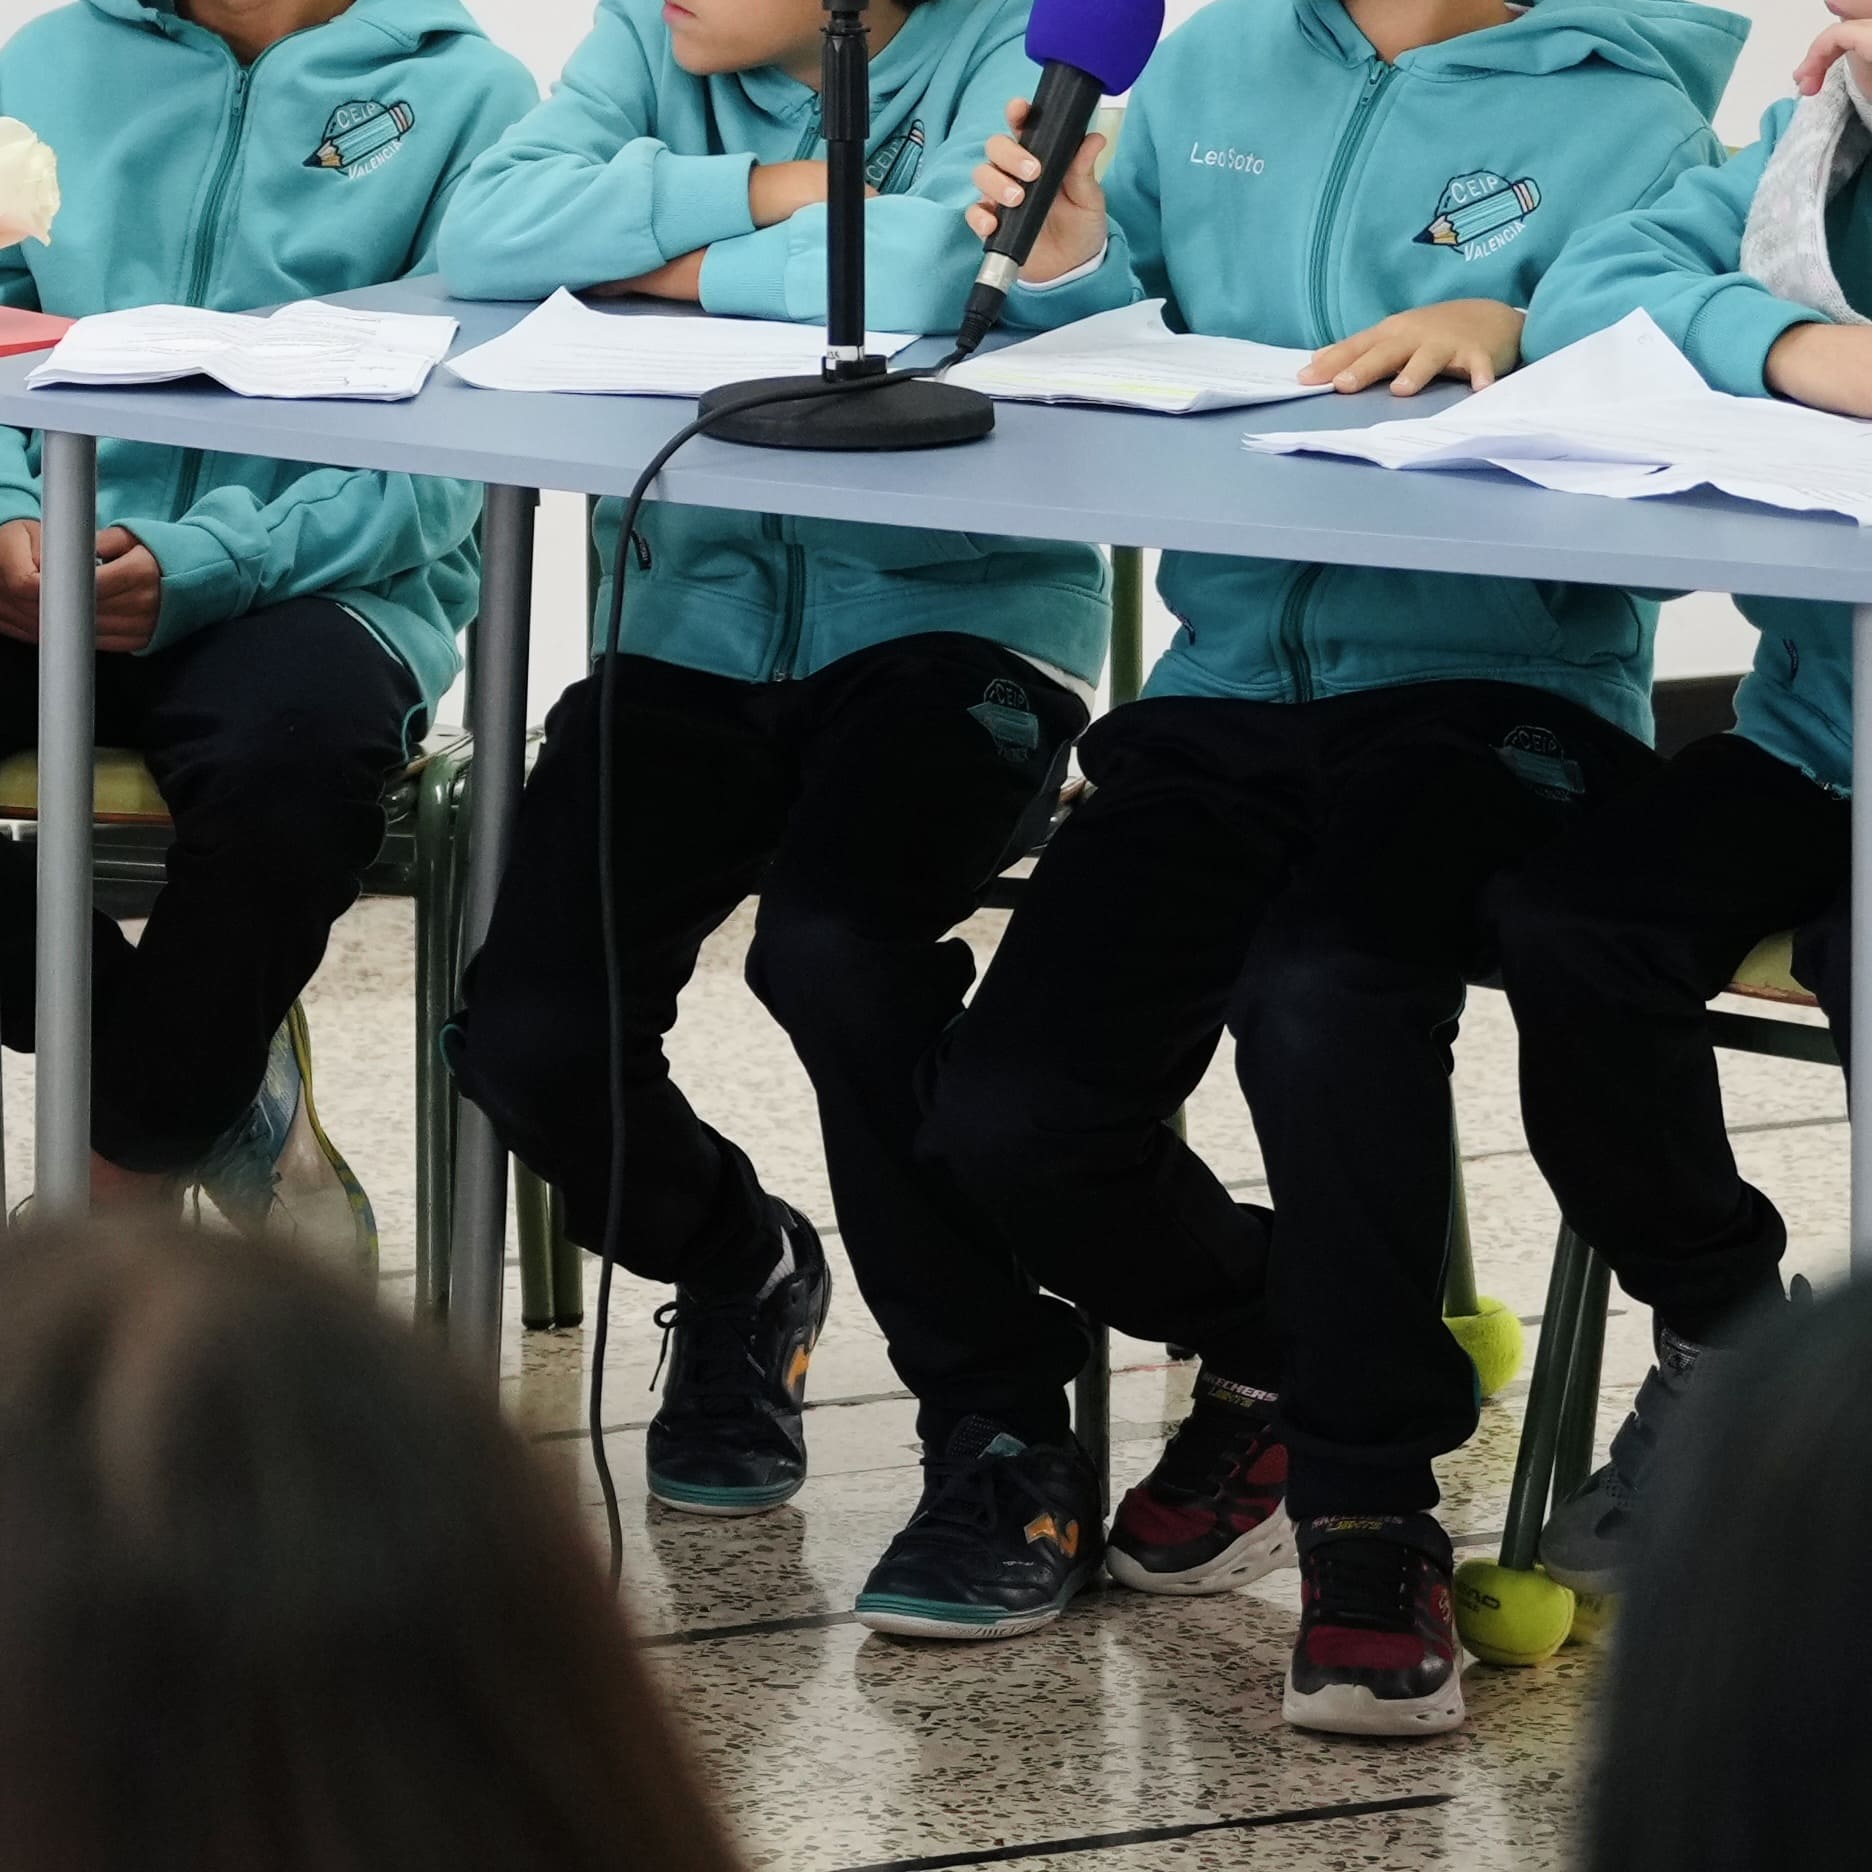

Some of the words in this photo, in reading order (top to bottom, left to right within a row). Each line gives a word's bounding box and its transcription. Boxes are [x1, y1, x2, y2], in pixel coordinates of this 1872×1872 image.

[336, 103, 376, 129] CEIP
[348, 140, 403, 179] VALENCIA
[1450, 176, 1500, 205] CEIP
[1462, 221, 1527, 263] VALENCIA
